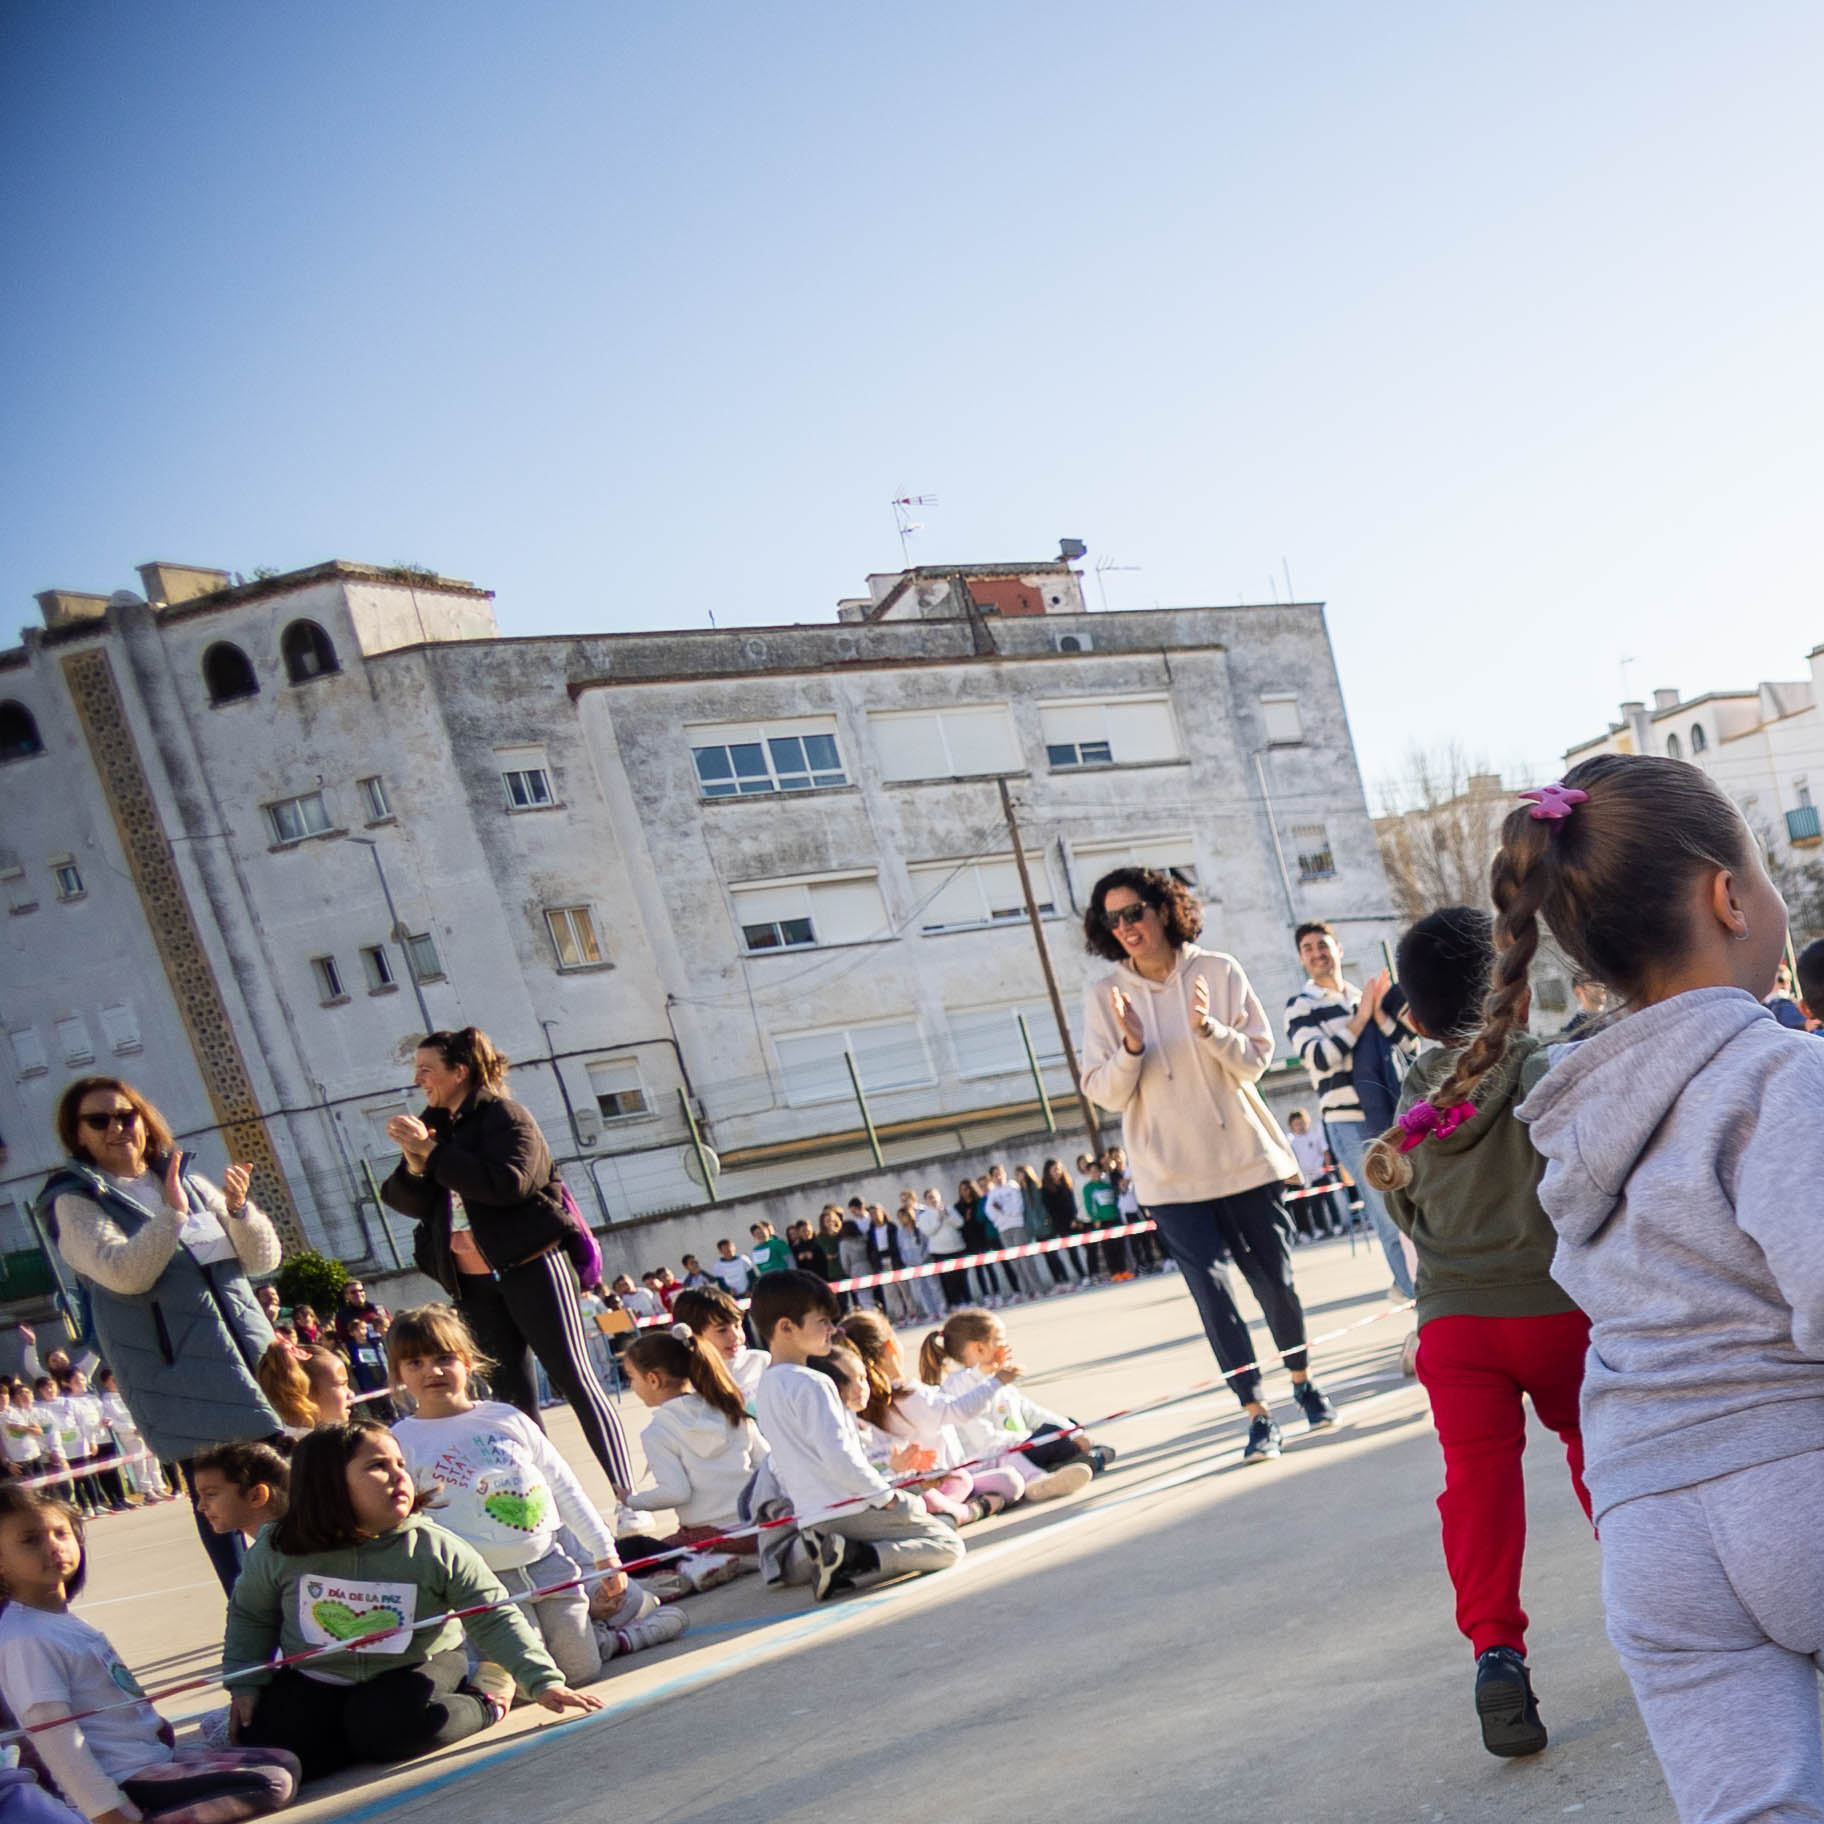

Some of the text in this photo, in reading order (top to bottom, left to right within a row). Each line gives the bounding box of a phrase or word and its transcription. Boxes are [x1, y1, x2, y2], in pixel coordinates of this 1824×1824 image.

[328, 1588, 346, 1600] DÍA
[348, 1592, 364, 1602] DE
[365, 1592, 379, 1603] LA
